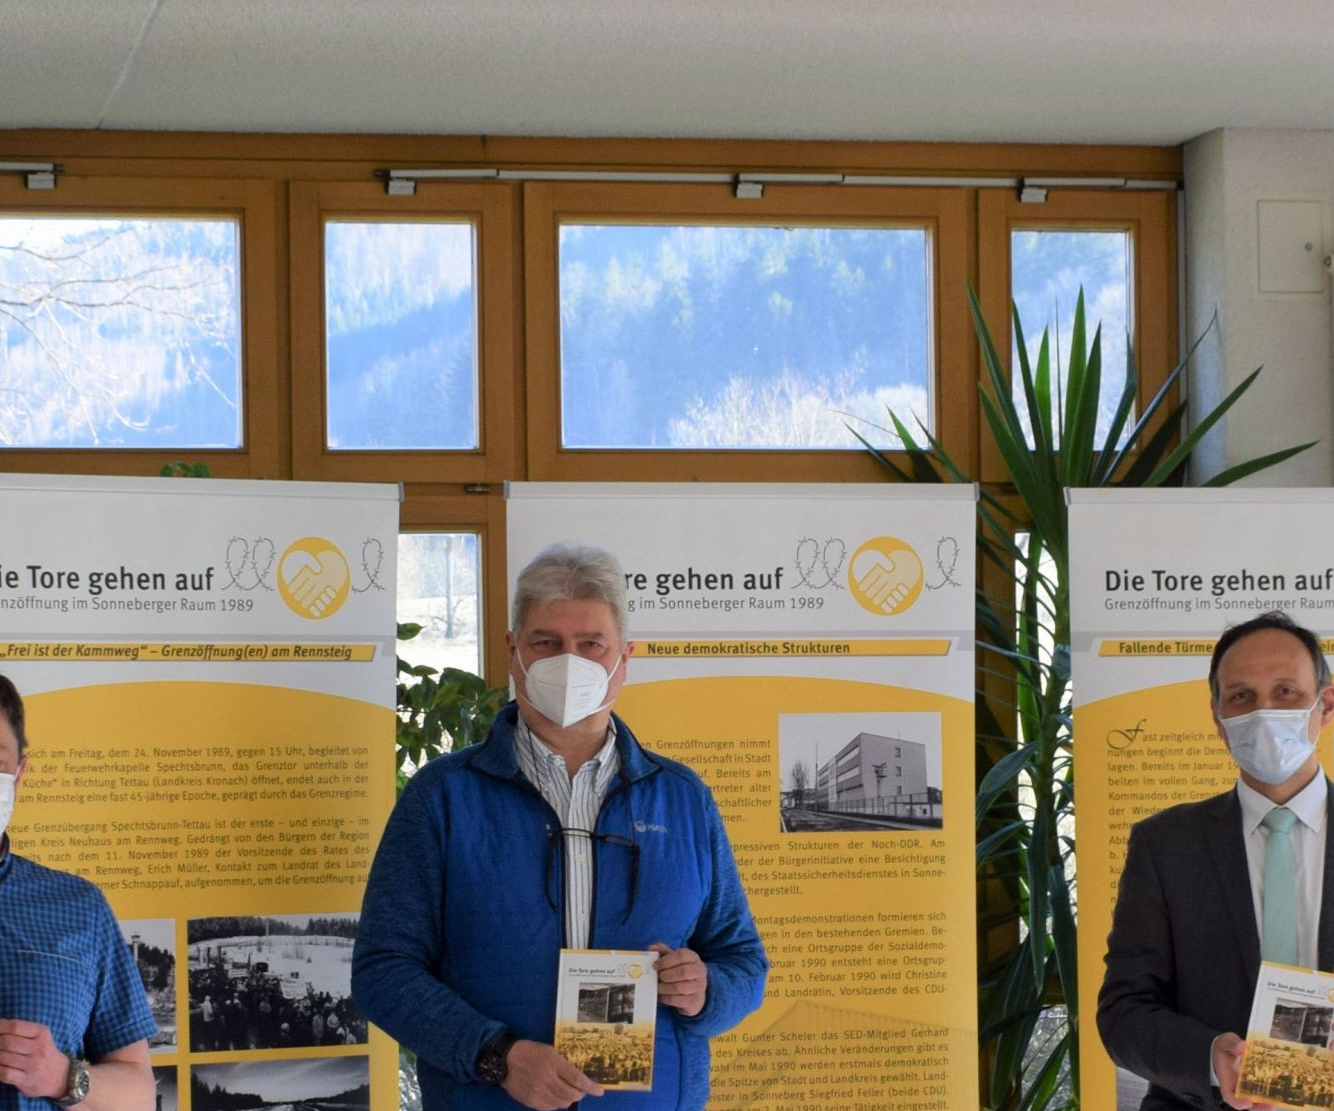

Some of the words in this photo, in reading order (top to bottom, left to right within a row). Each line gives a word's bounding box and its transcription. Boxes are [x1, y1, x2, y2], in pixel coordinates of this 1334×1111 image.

[25, 564, 80, 590] Tore
[87, 565, 166, 595] gehen
[174, 565, 215, 592] auf
[625, 572, 648, 591] re
[655, 566, 734, 595] gehen
[742, 565, 784, 591] auf
[1104, 568, 1145, 592] Die
[1150, 569, 1204, 592] Tore
[1210, 567, 1286, 597] gehen
[1293, 567, 1334, 591] auf
[71, 595, 89, 610] im
[90, 595, 178, 614] Sonneberger
[179, 596, 216, 612] Raum
[219, 597, 254, 613] 1989
[638, 596, 656, 610] im
[658, 595, 746, 613] Sonneberger
[748, 595, 786, 610] Raum
[789, 596, 825, 610] 1989
[1103, 596, 1193, 613] Grenzöffnung
[1194, 596, 1212, 610] im
[1213, 594, 1297, 614] Sonneberger
[33, 643, 50, 658] ist
[52, 643, 74, 658] der
[76, 643, 149, 661] Kammweg“
[161, 643, 269, 662] Grenzöffnung(en)
[271, 647, 291, 658] am
[293, 644, 353, 663] Rennsteig
[646, 642, 680, 656] Neue
[682, 641, 779, 655] demokratische
[781, 641, 851, 656] Strukturen
[1118, 640, 1172, 654] Fallende
[1173, 640, 1214, 655] Türme
